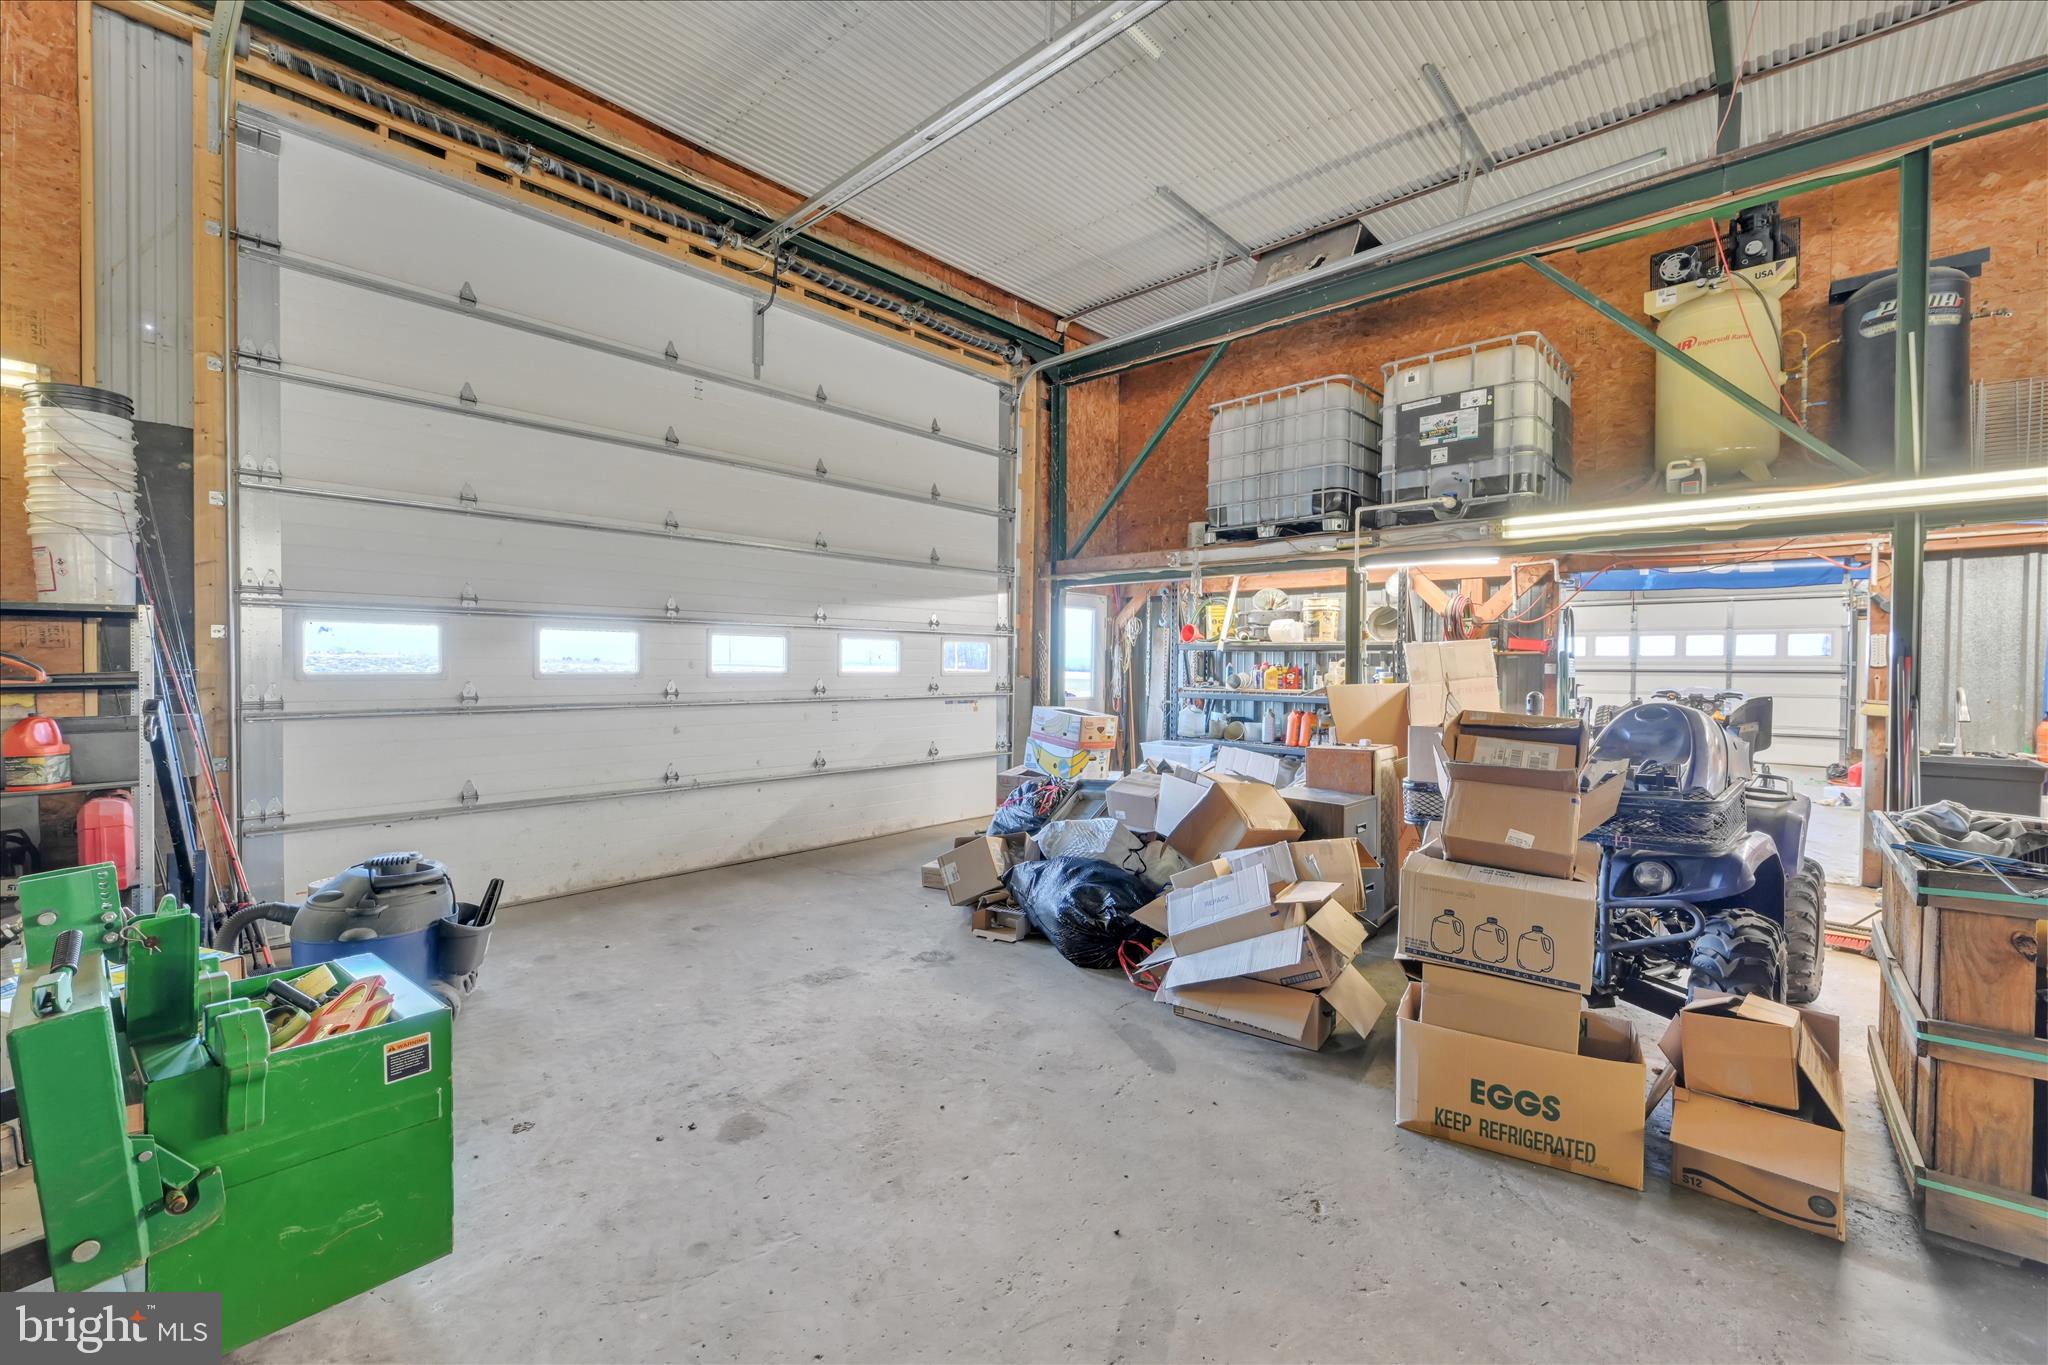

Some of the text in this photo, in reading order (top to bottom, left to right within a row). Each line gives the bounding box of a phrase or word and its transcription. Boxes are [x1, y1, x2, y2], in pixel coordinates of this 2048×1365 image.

[1754, 269, 1774, 280] USA
[1697, 334, 1730, 347] Ingersoll
[1463, 959, 1508, 975] GALLON
[1514, 971, 1568, 989] BOTTLES
[398, 1036, 427, 1048] WARNING
[1470, 1078, 1561, 1122] EGGS
[1434, 1106, 1597, 1164] KEEP REFRIGERATED
[1682, 1174, 1703, 1189] S12
